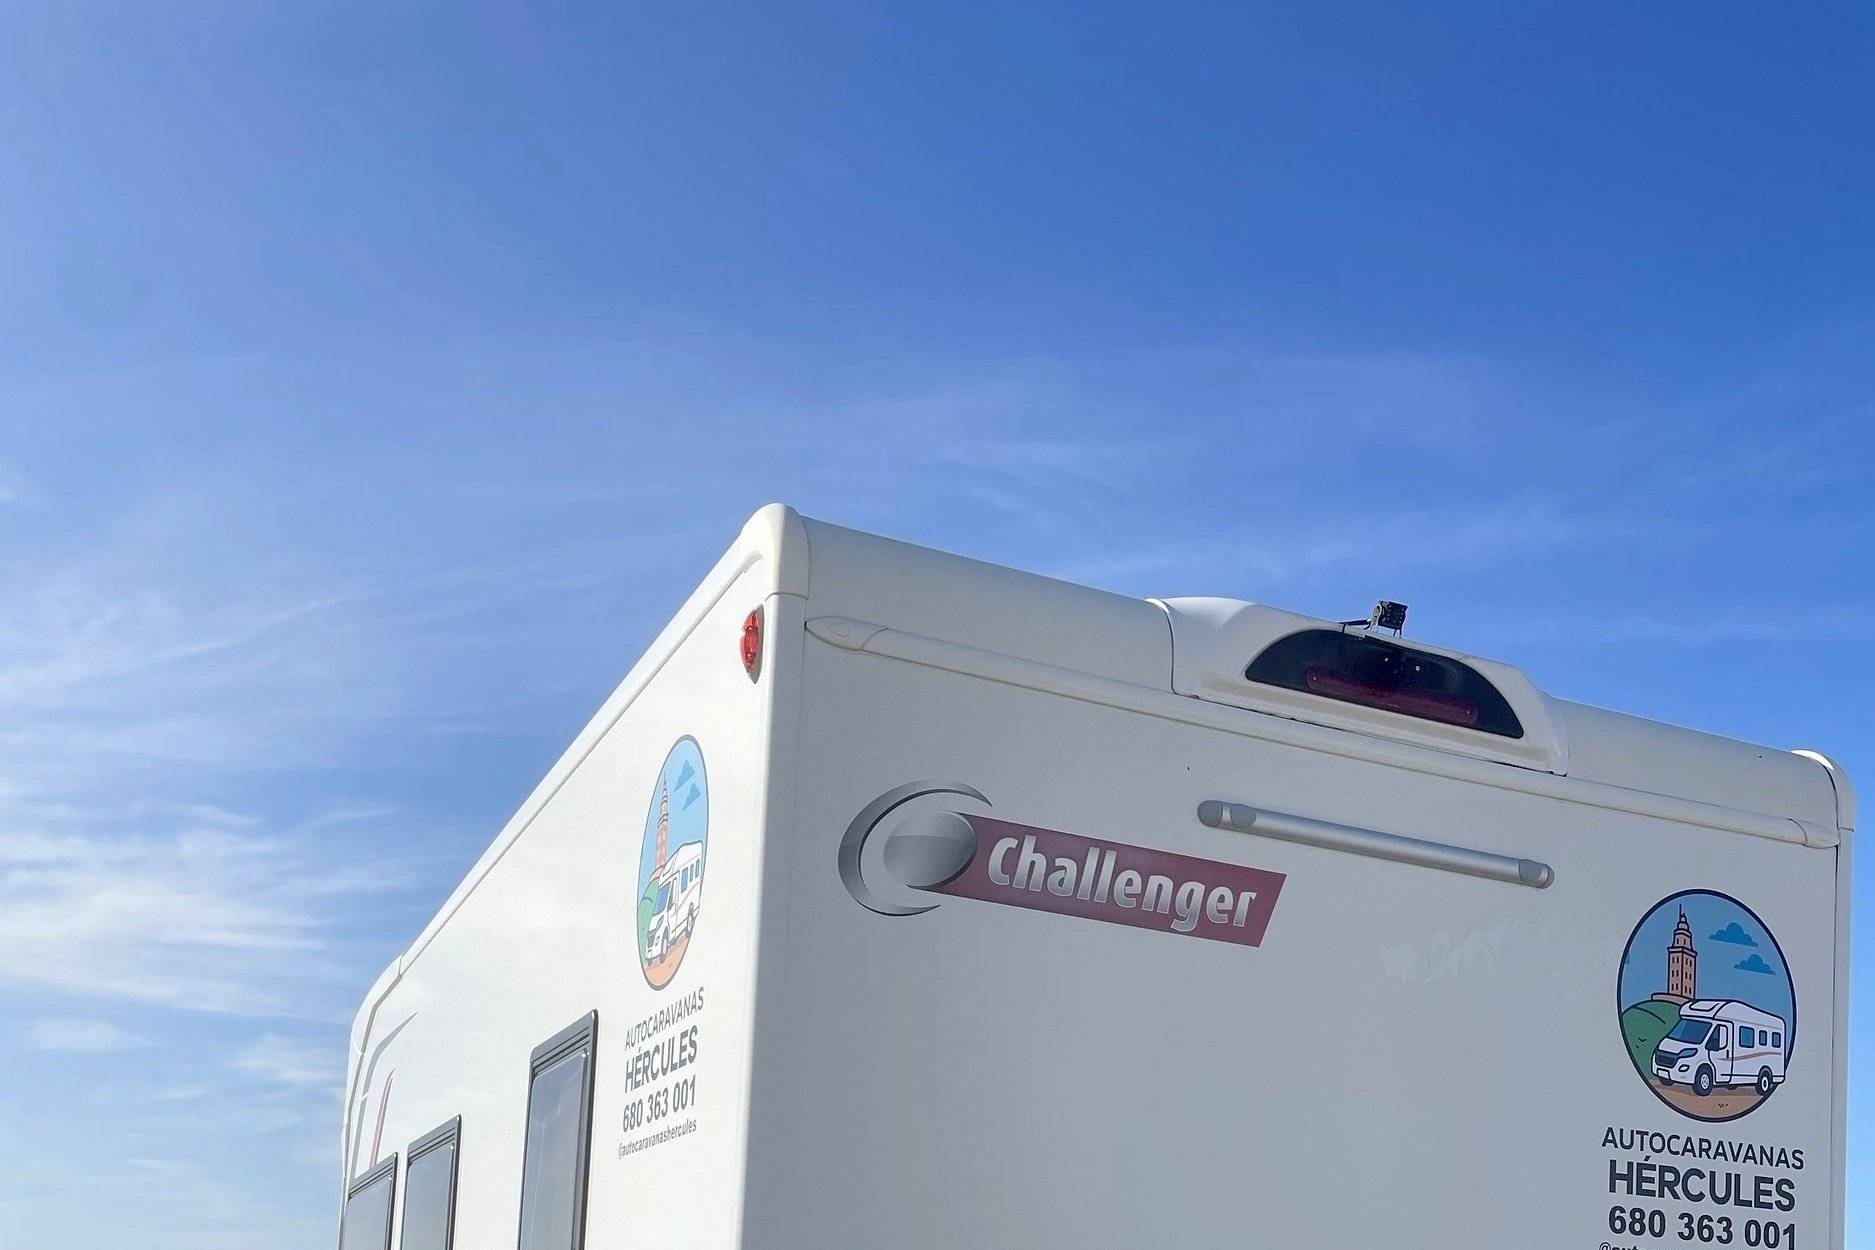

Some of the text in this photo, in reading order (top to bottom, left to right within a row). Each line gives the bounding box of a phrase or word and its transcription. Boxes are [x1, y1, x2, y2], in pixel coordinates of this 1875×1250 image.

[988, 833, 1257, 933] Challenger
[624, 986, 704, 1051] AUTOCARAVANAS
[625, 1024, 698, 1093] HÉRCULES
[622, 1074, 696, 1133] 680 363 001
[1601, 1126, 1804, 1170] AUTOCARAVANAS
[1608, 1155, 1796, 1212] HÉRCULES
[1608, 1205, 1796, 1250] 680 363 001
